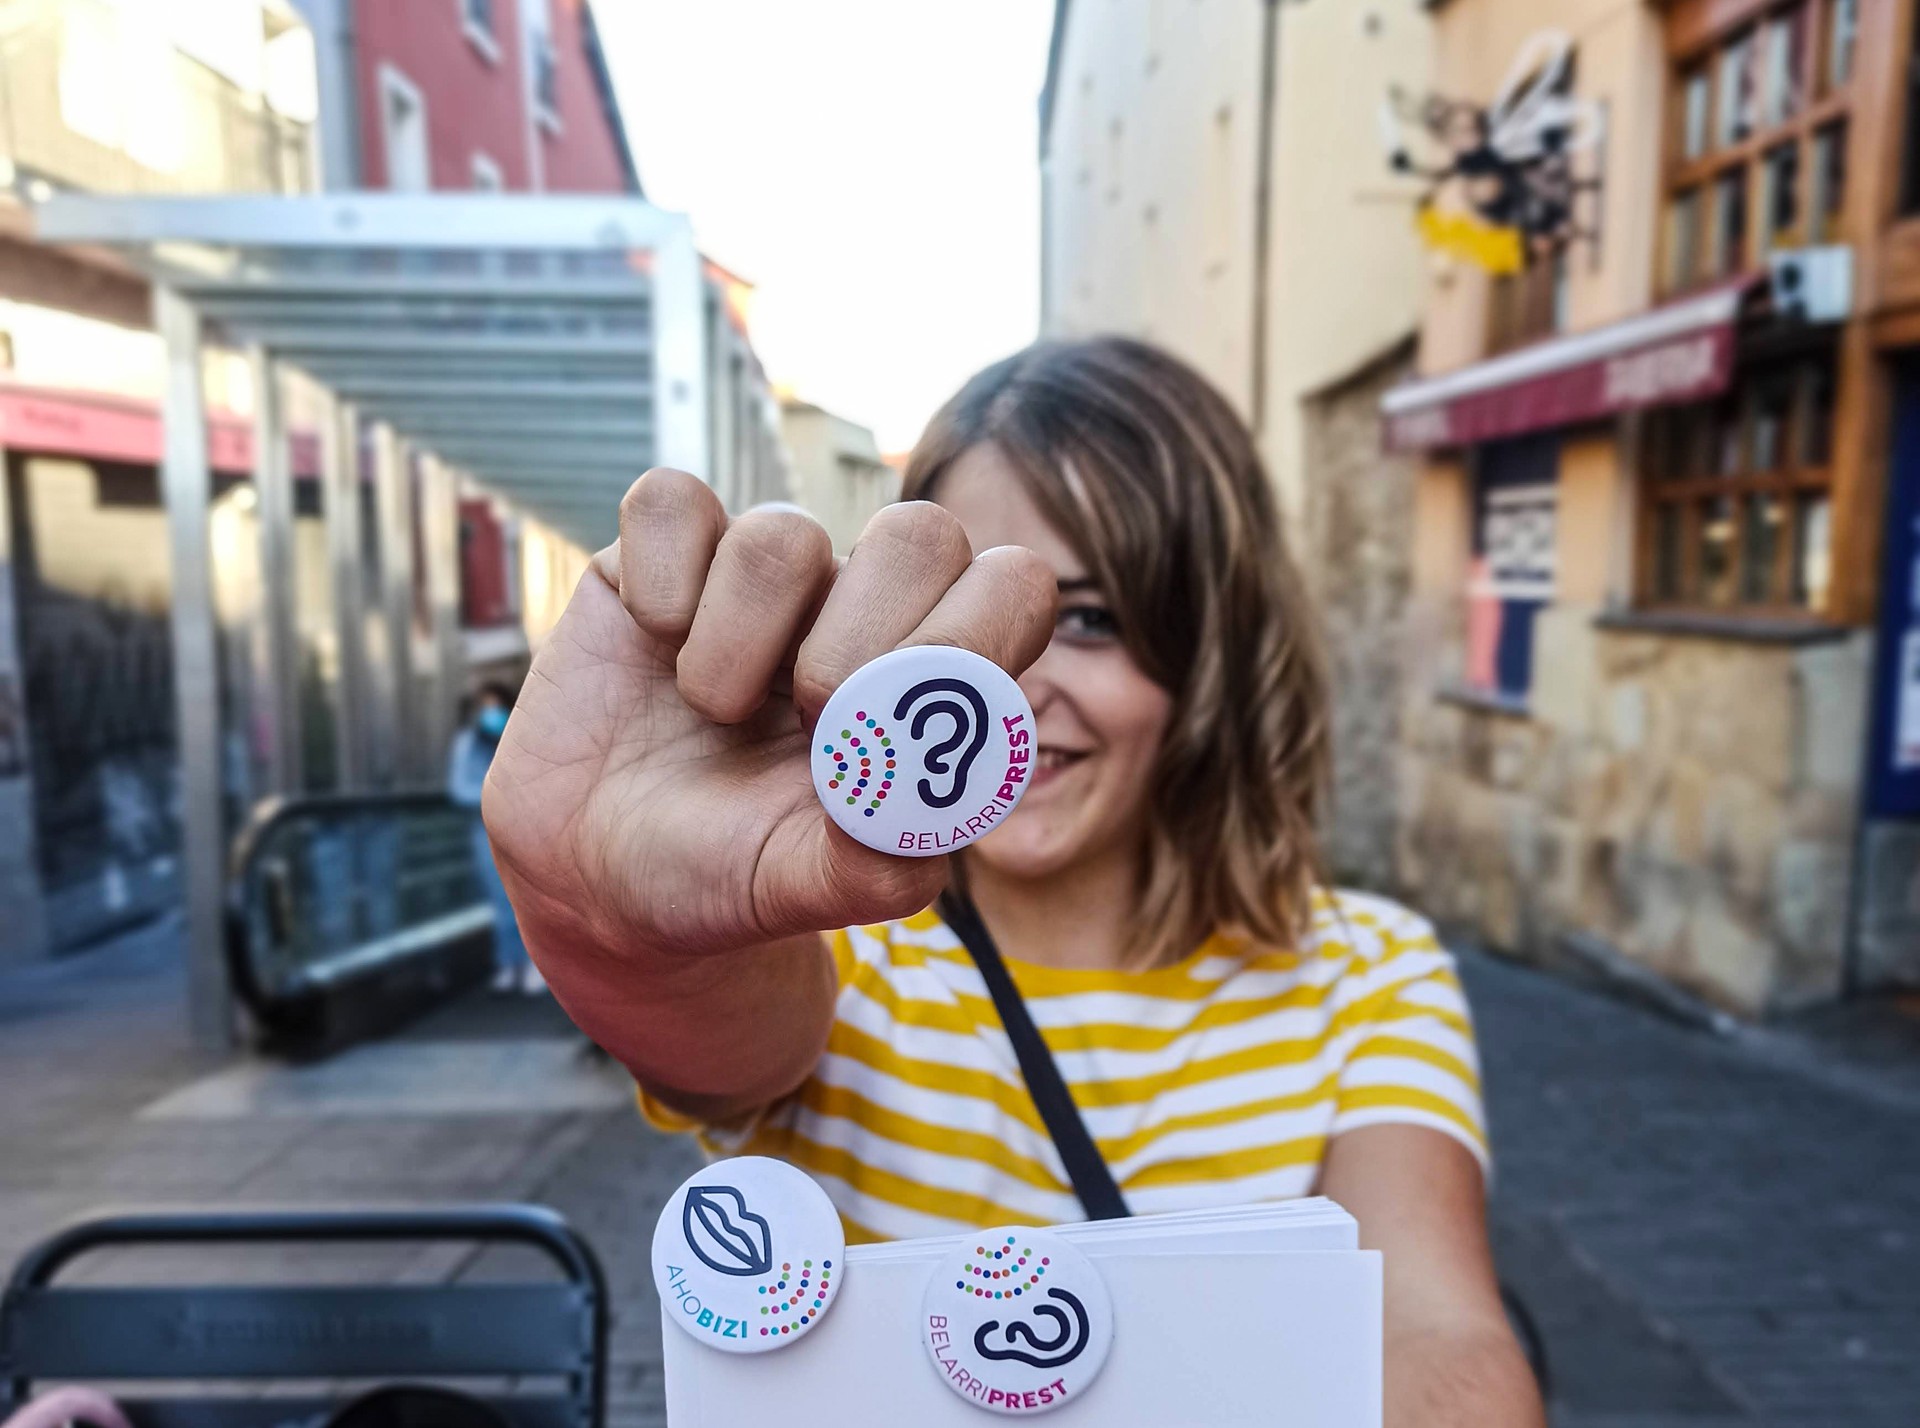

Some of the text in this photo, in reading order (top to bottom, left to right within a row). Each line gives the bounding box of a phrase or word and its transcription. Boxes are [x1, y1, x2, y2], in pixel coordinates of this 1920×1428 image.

[898, 714, 1029, 850] BELARRIPREST
[666, 1265, 748, 1338] AHOBIZI
[930, 1315, 1068, 1408] BELARRIPREST
